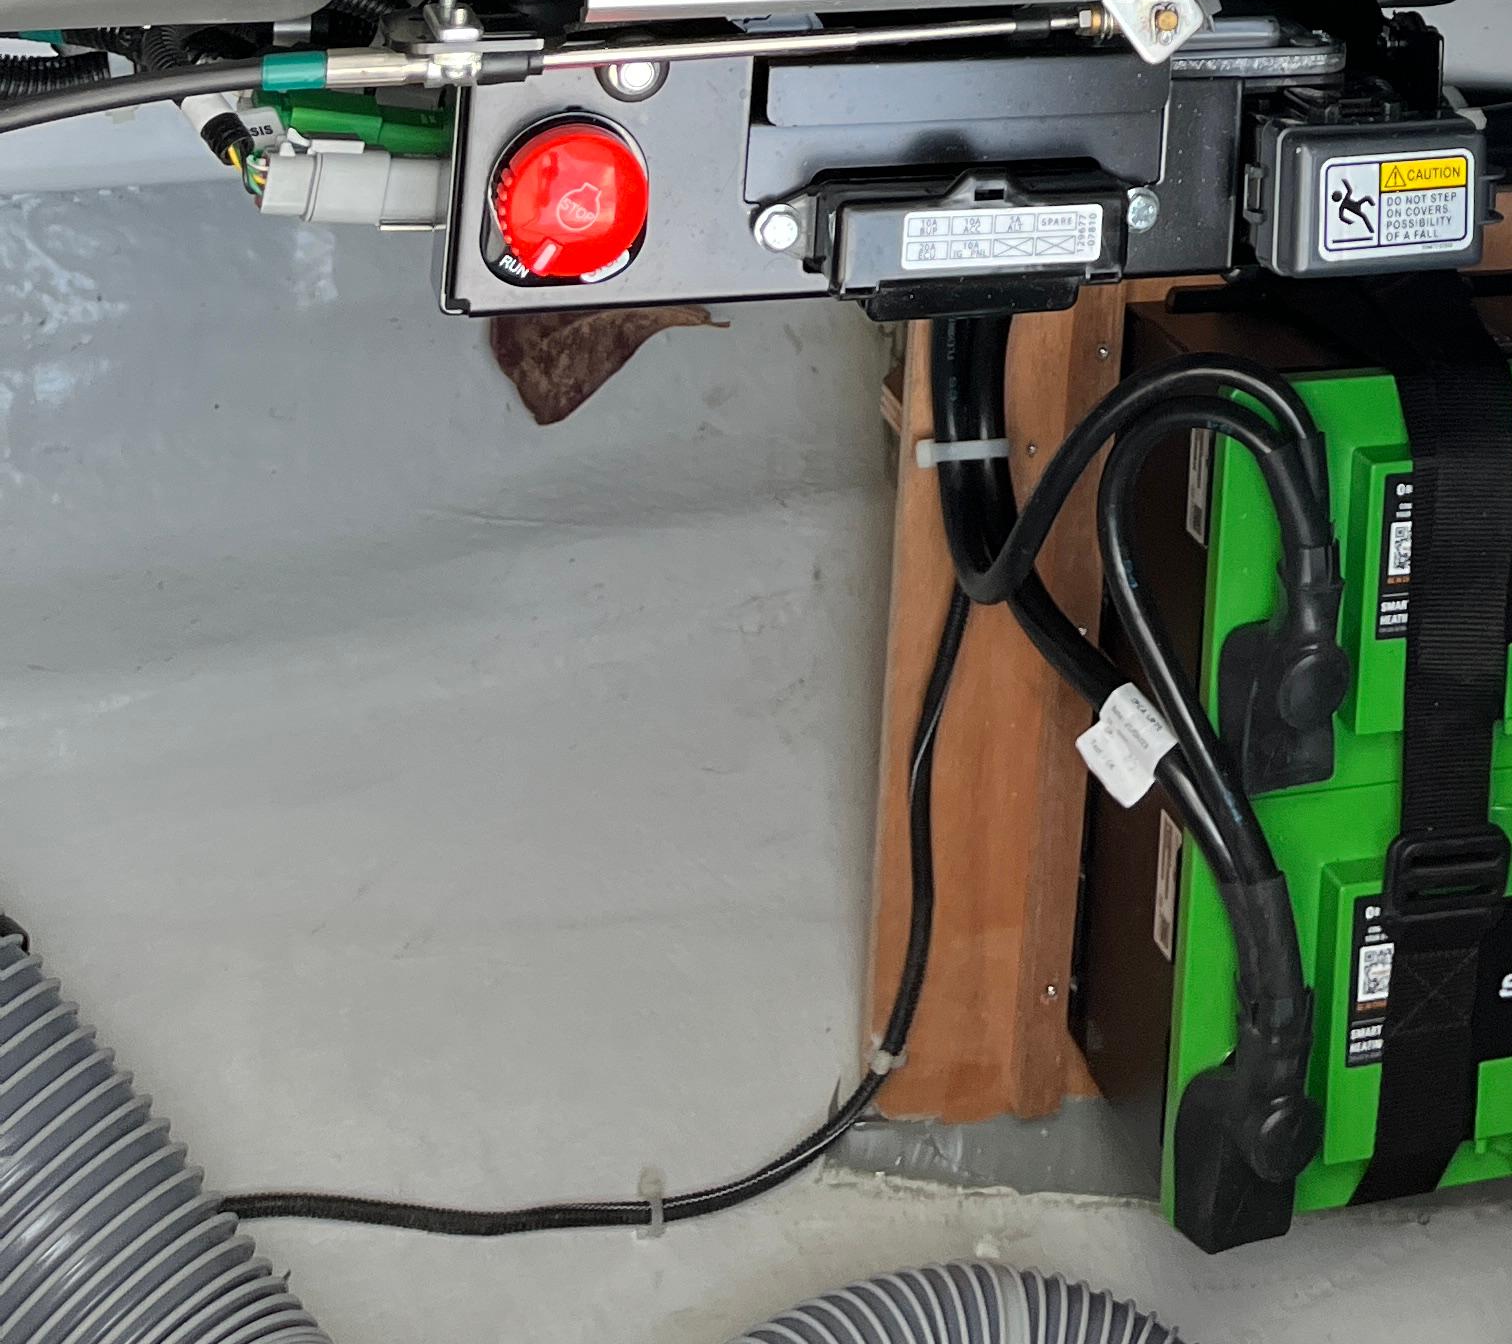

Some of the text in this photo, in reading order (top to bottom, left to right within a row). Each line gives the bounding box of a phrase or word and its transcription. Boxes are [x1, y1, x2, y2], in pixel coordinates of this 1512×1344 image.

[1406, 166, 1460, 181] CAUTION
[1386, 191, 1456, 206] DO NOT STEP
[560, 197, 595, 221] STOP
[1386, 207, 1401, 218] ON
[1041, 216, 1072, 226] SPARE
[1386, 216, 1452, 229] POSSIBILITY
[1385, 232, 1399, 241] OF
[1403, 230, 1410, 239] A
[499, 253, 529, 279] RUN
